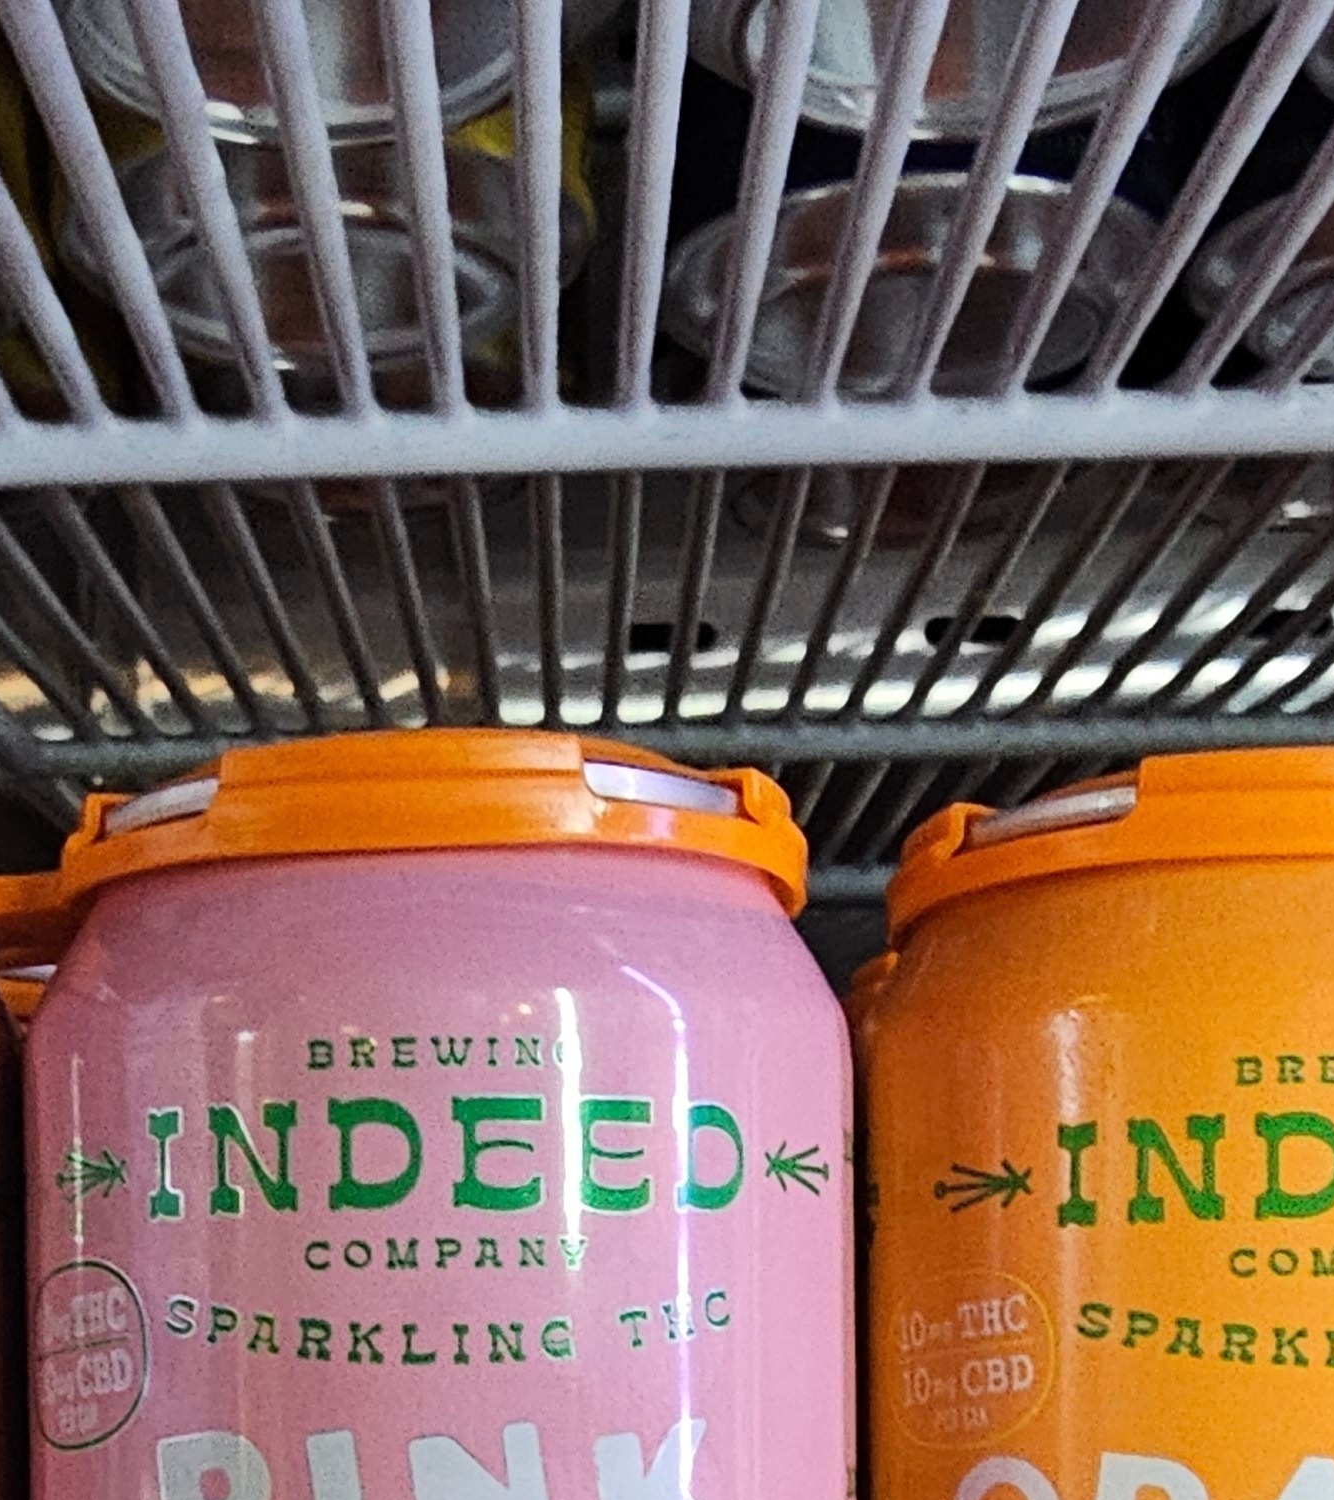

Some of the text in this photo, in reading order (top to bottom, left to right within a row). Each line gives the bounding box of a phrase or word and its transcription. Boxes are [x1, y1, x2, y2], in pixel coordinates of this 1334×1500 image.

[307, 1036, 581, 1071] BREWIN
[146, 1096, 745, 1221] INDEED
[304, 1235, 587, 1272] COMPANY
[165, 1290, 732, 1366] SPARKLING THC
[958, 1294, 1029, 1339] THC
[961, 1353, 1035, 1397] CBD
